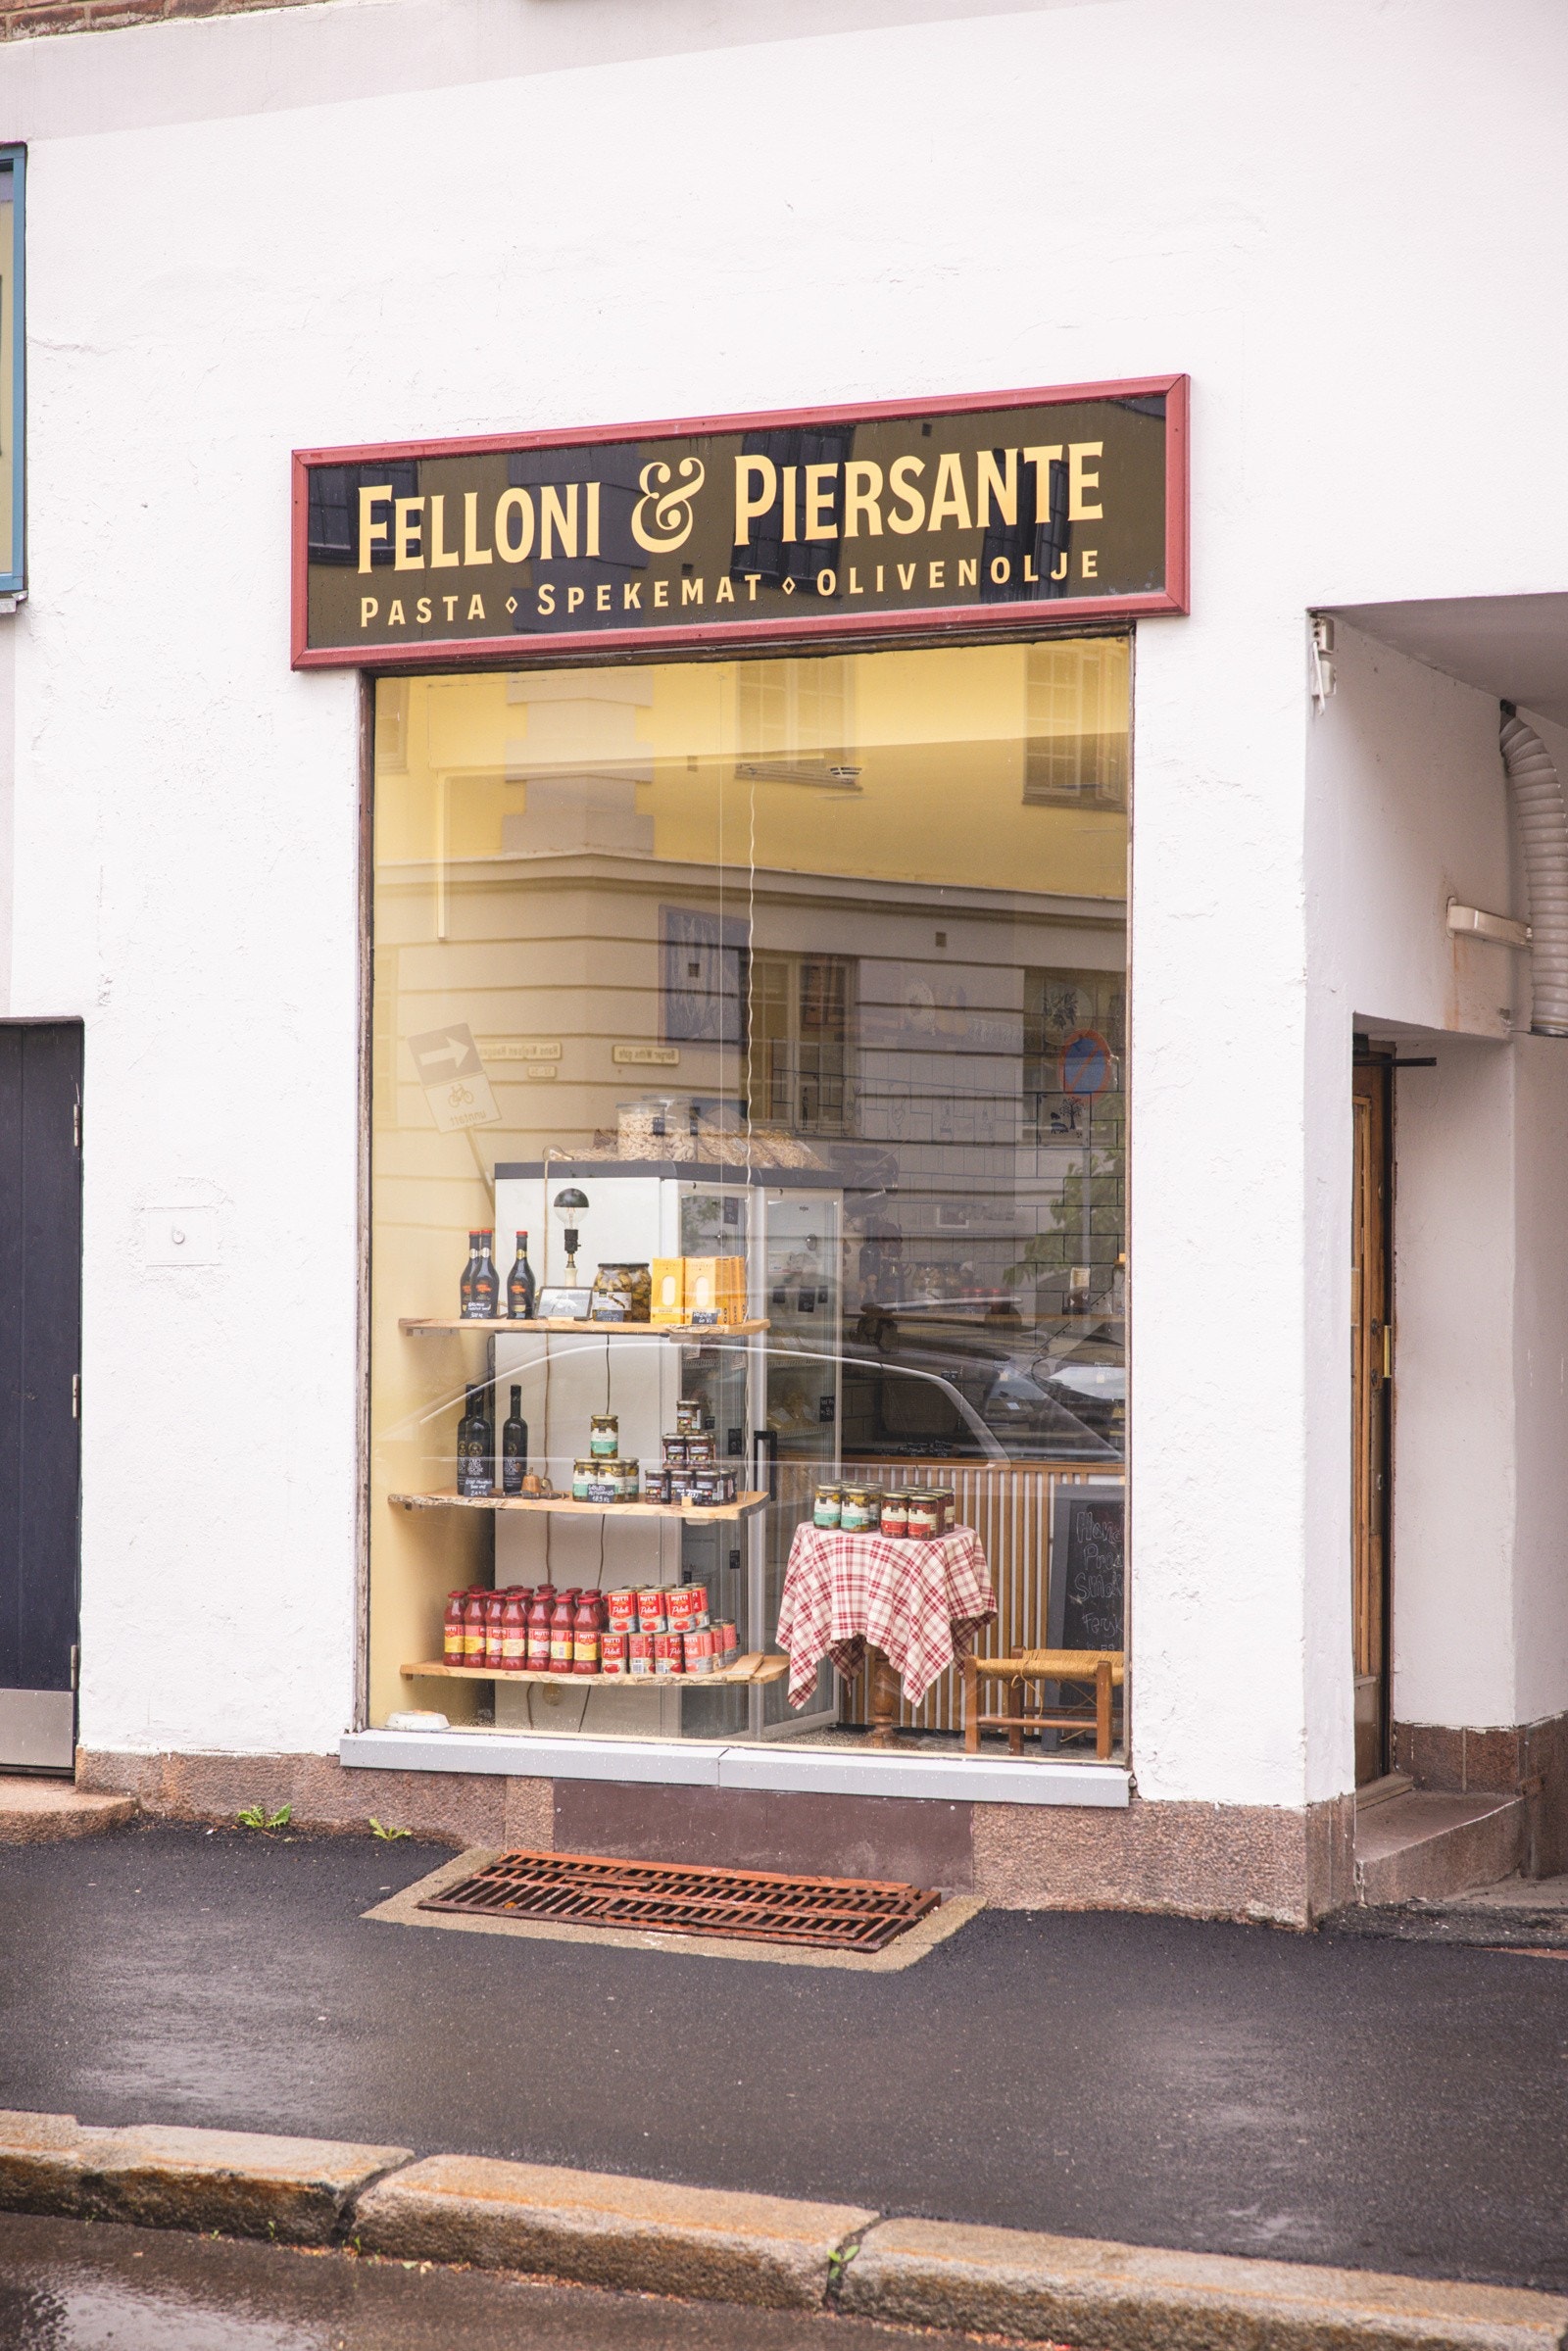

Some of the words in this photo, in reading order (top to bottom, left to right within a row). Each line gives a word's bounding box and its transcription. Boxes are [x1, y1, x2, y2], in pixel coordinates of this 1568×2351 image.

[357, 481, 601, 574] FELLONI
[630, 457, 706, 554] &
[734, 440, 1104, 547] PIERSANTE
[360, 593, 486, 628] PASTA
[537, 573, 761, 615] SPEKEMAT
[816, 550, 1100, 598] OLIVENOLJE
[670, 1593, 689, 1602] MUTTI
